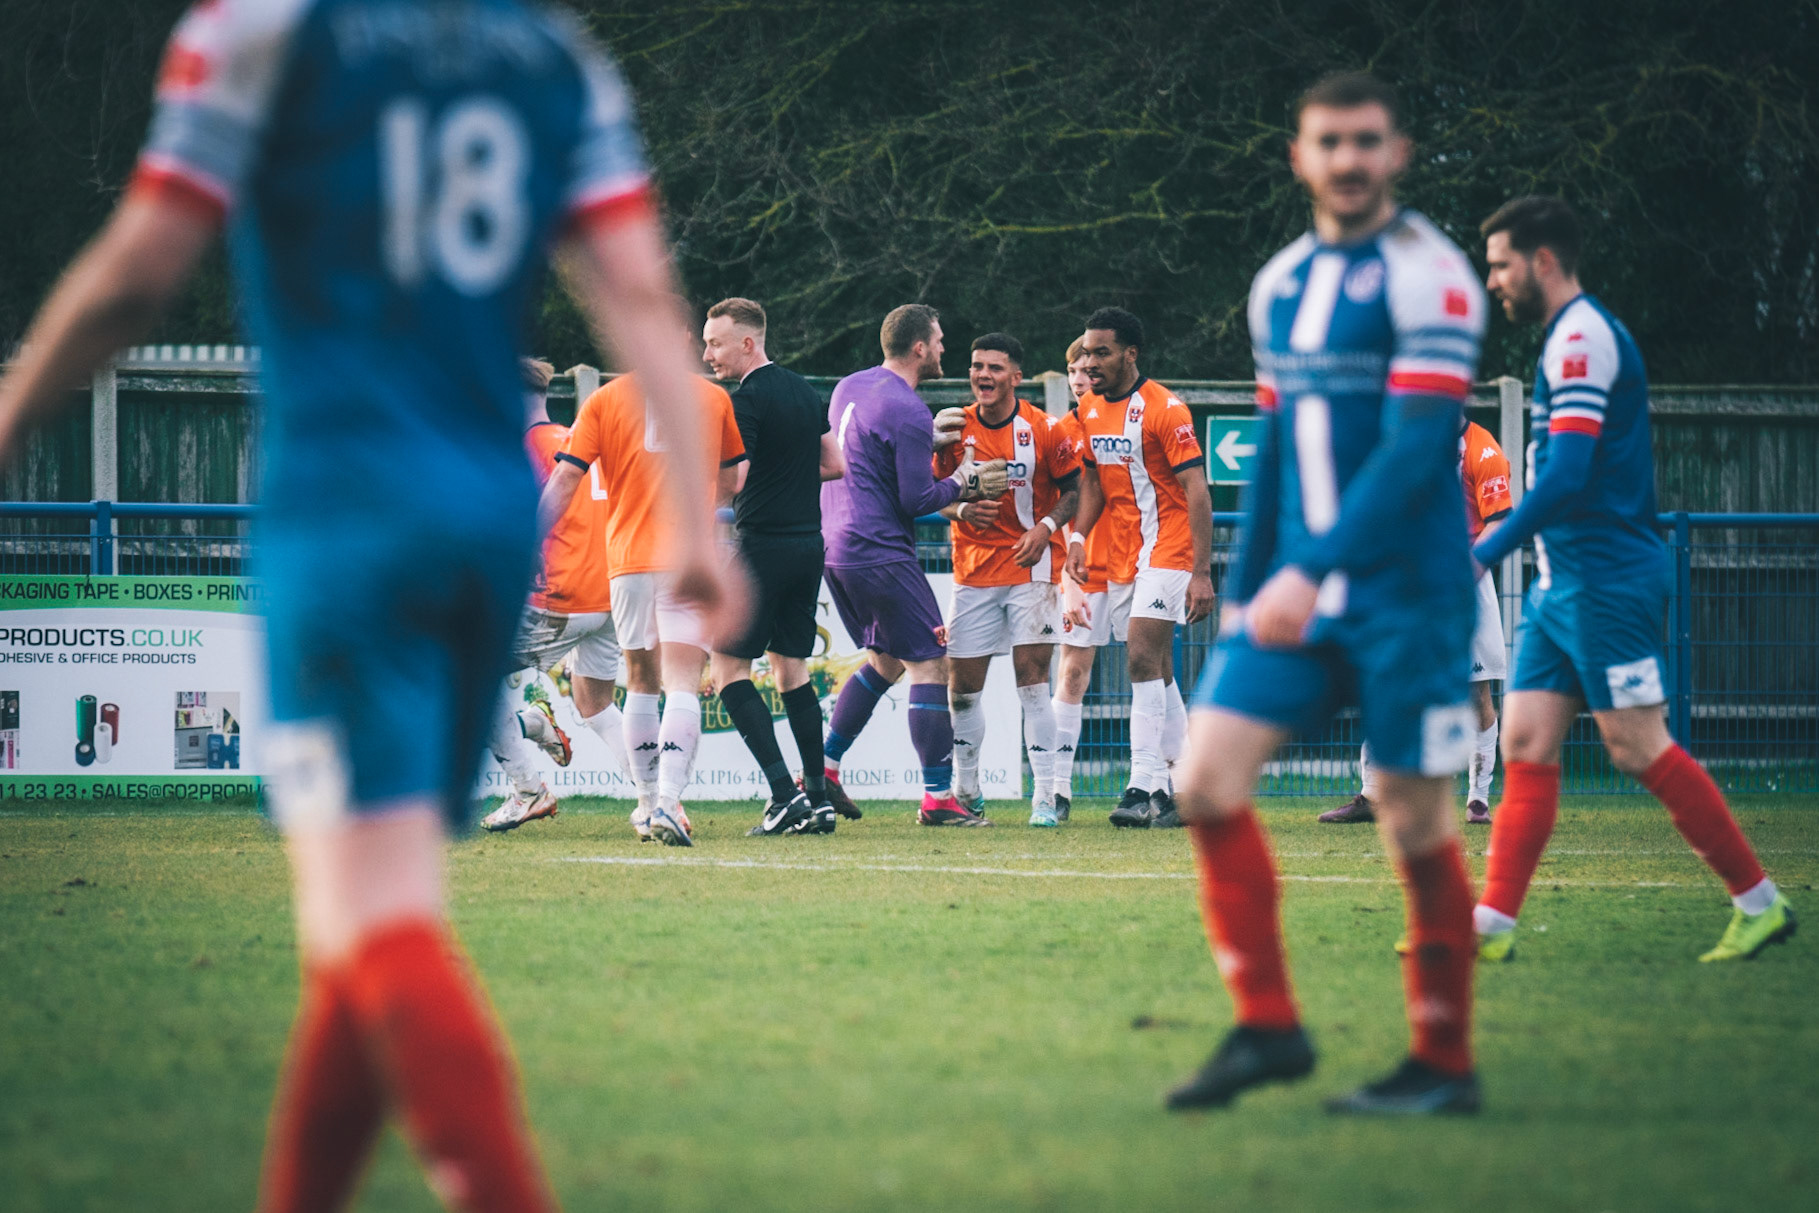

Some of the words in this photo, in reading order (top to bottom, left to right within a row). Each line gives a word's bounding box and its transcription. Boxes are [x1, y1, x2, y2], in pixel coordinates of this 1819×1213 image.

[381, 100, 530, 294] 18
[0, 582, 70, 600] KAGING
[74, 583, 120, 600] TAPE
[134, 583, 193, 600] BOXES
[207, 584, 264, 601] PRINT
[58, 653, 68, 664] &
[72, 653, 118, 664] OFFICE
[122, 653, 197, 664] PRODUCTS
[486, 771, 544, 786] STRT
[711, 770, 742, 785] IP16
[746, 770, 772, 785] 4E
[24, 783, 47, 800] 23
[54, 783, 77, 800] 23
